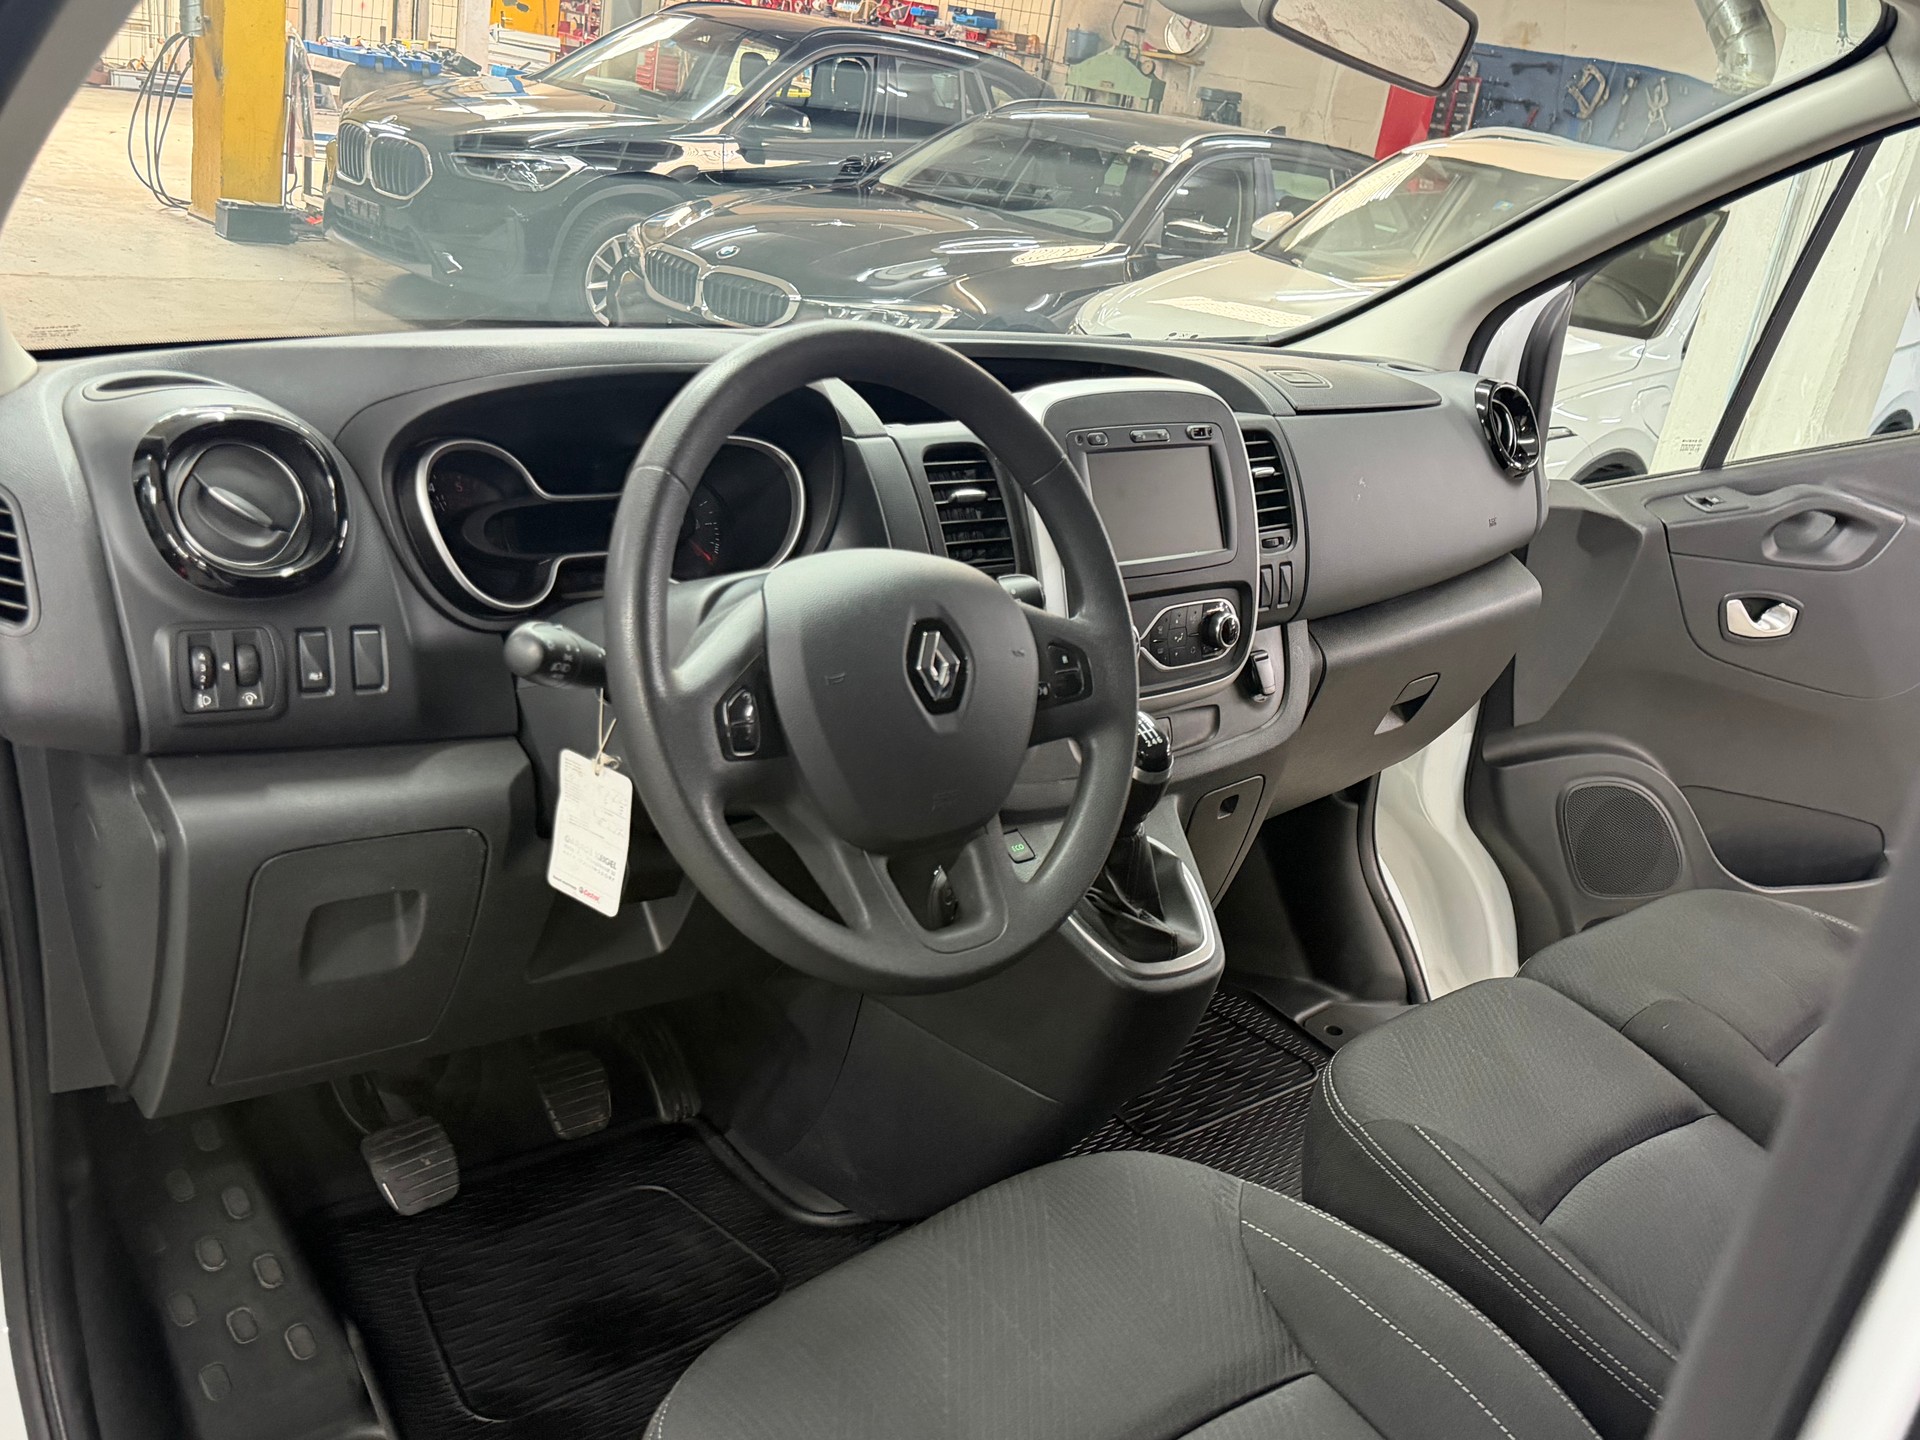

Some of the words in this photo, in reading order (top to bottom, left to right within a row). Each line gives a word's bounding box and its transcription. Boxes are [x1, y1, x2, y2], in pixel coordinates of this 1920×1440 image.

[198, 652, 206, 661] 4
[200, 664, 207, 672] 3
[200, 675, 207, 683] 2
[1011, 843, 1025, 852] ECO
